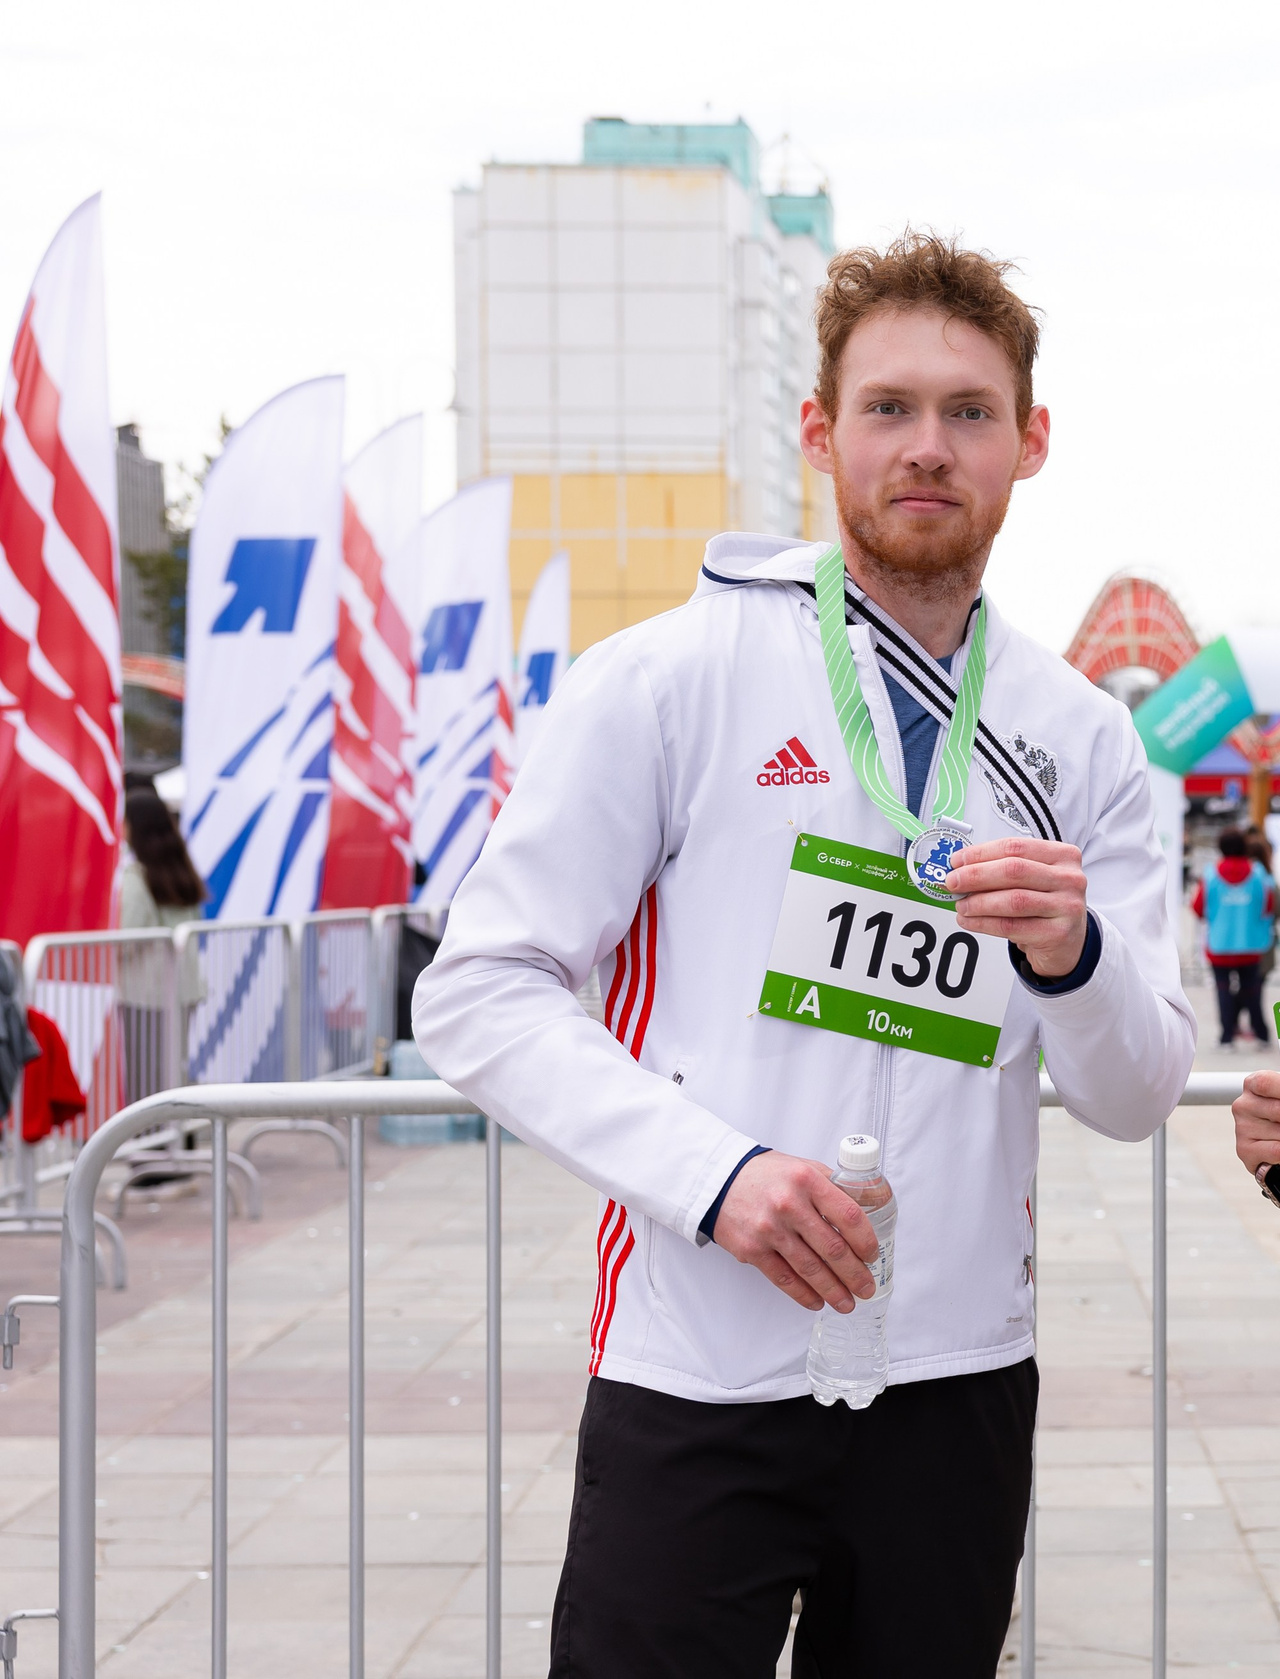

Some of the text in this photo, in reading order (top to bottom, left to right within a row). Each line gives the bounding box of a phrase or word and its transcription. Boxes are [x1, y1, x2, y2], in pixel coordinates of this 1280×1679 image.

[756, 767, 830, 787] adidas
[829, 856, 853, 868] СБЕР
[924, 864, 947, 881] 50
[827, 901, 980, 999] 1130
